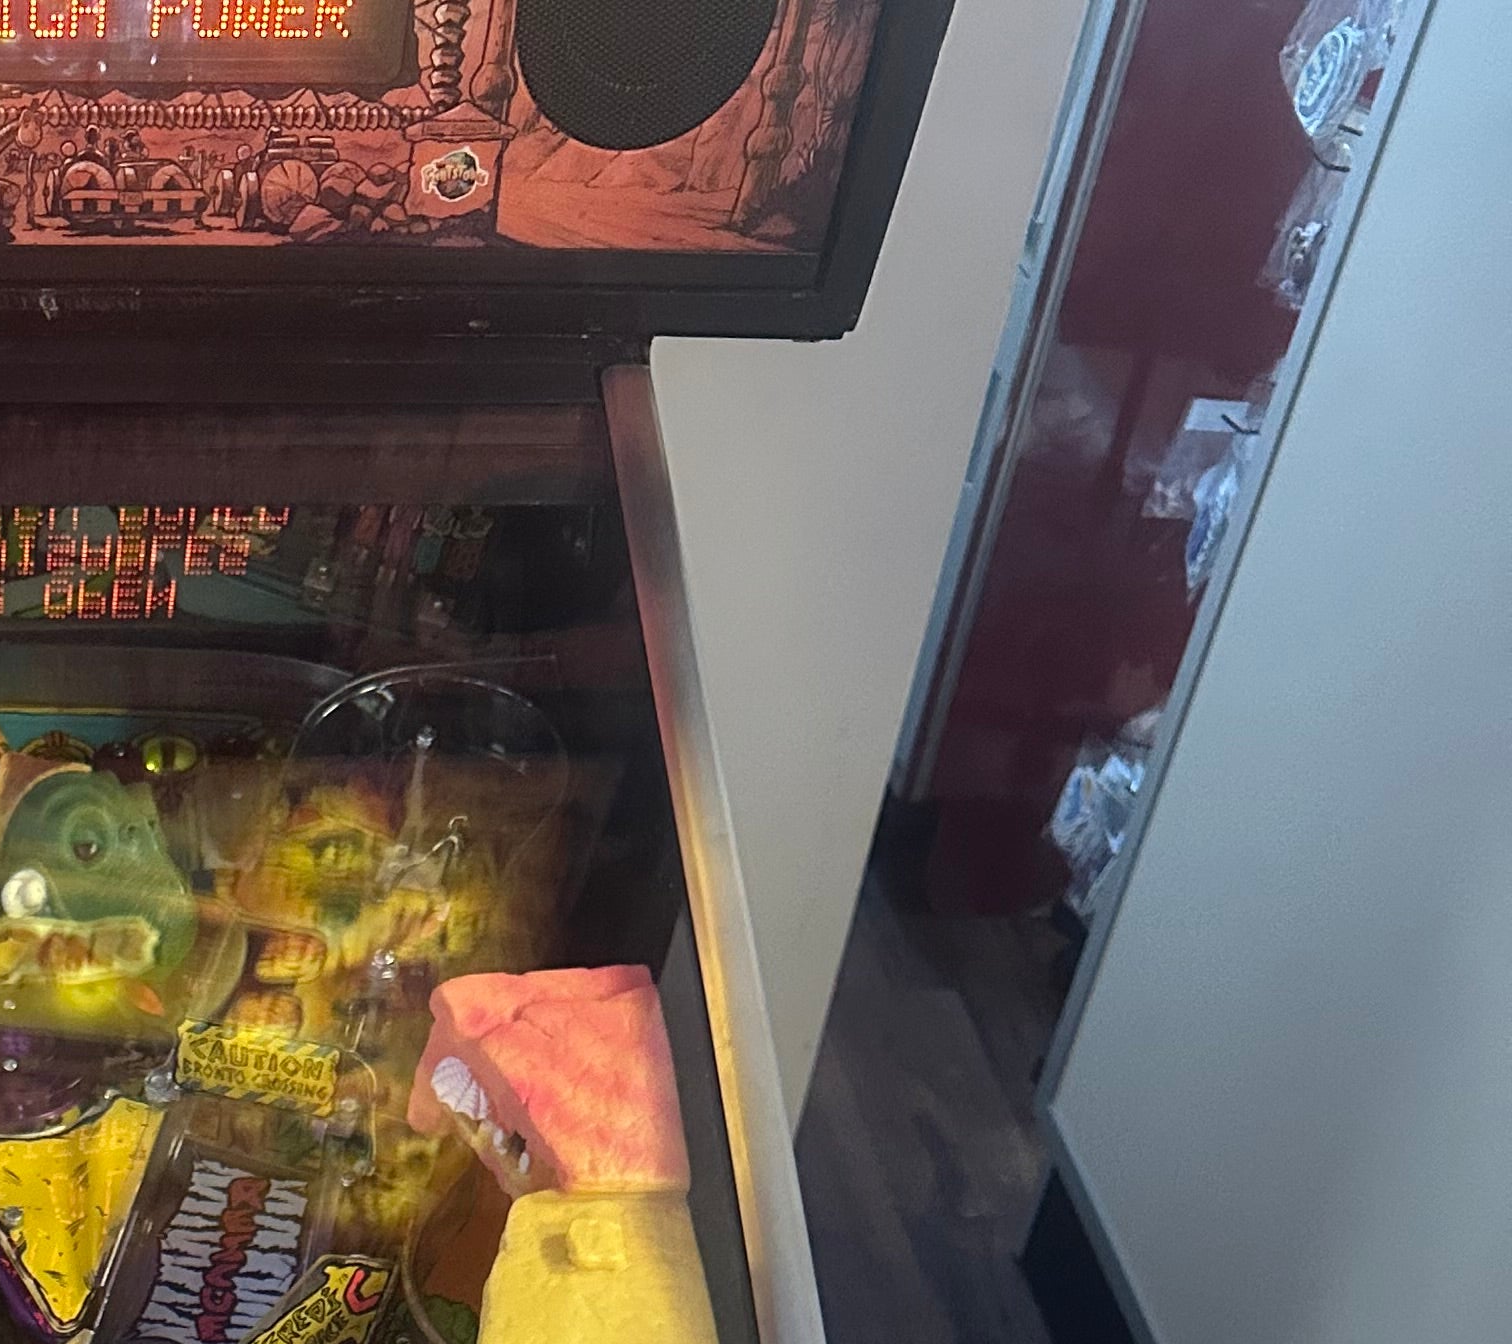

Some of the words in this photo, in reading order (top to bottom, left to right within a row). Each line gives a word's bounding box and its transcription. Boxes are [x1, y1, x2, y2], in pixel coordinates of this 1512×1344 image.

[182, 1057, 246, 1085] BRONTO
[251, 1071, 330, 1101] CROSSING
[189, 1037, 323, 1081] CAUTION
